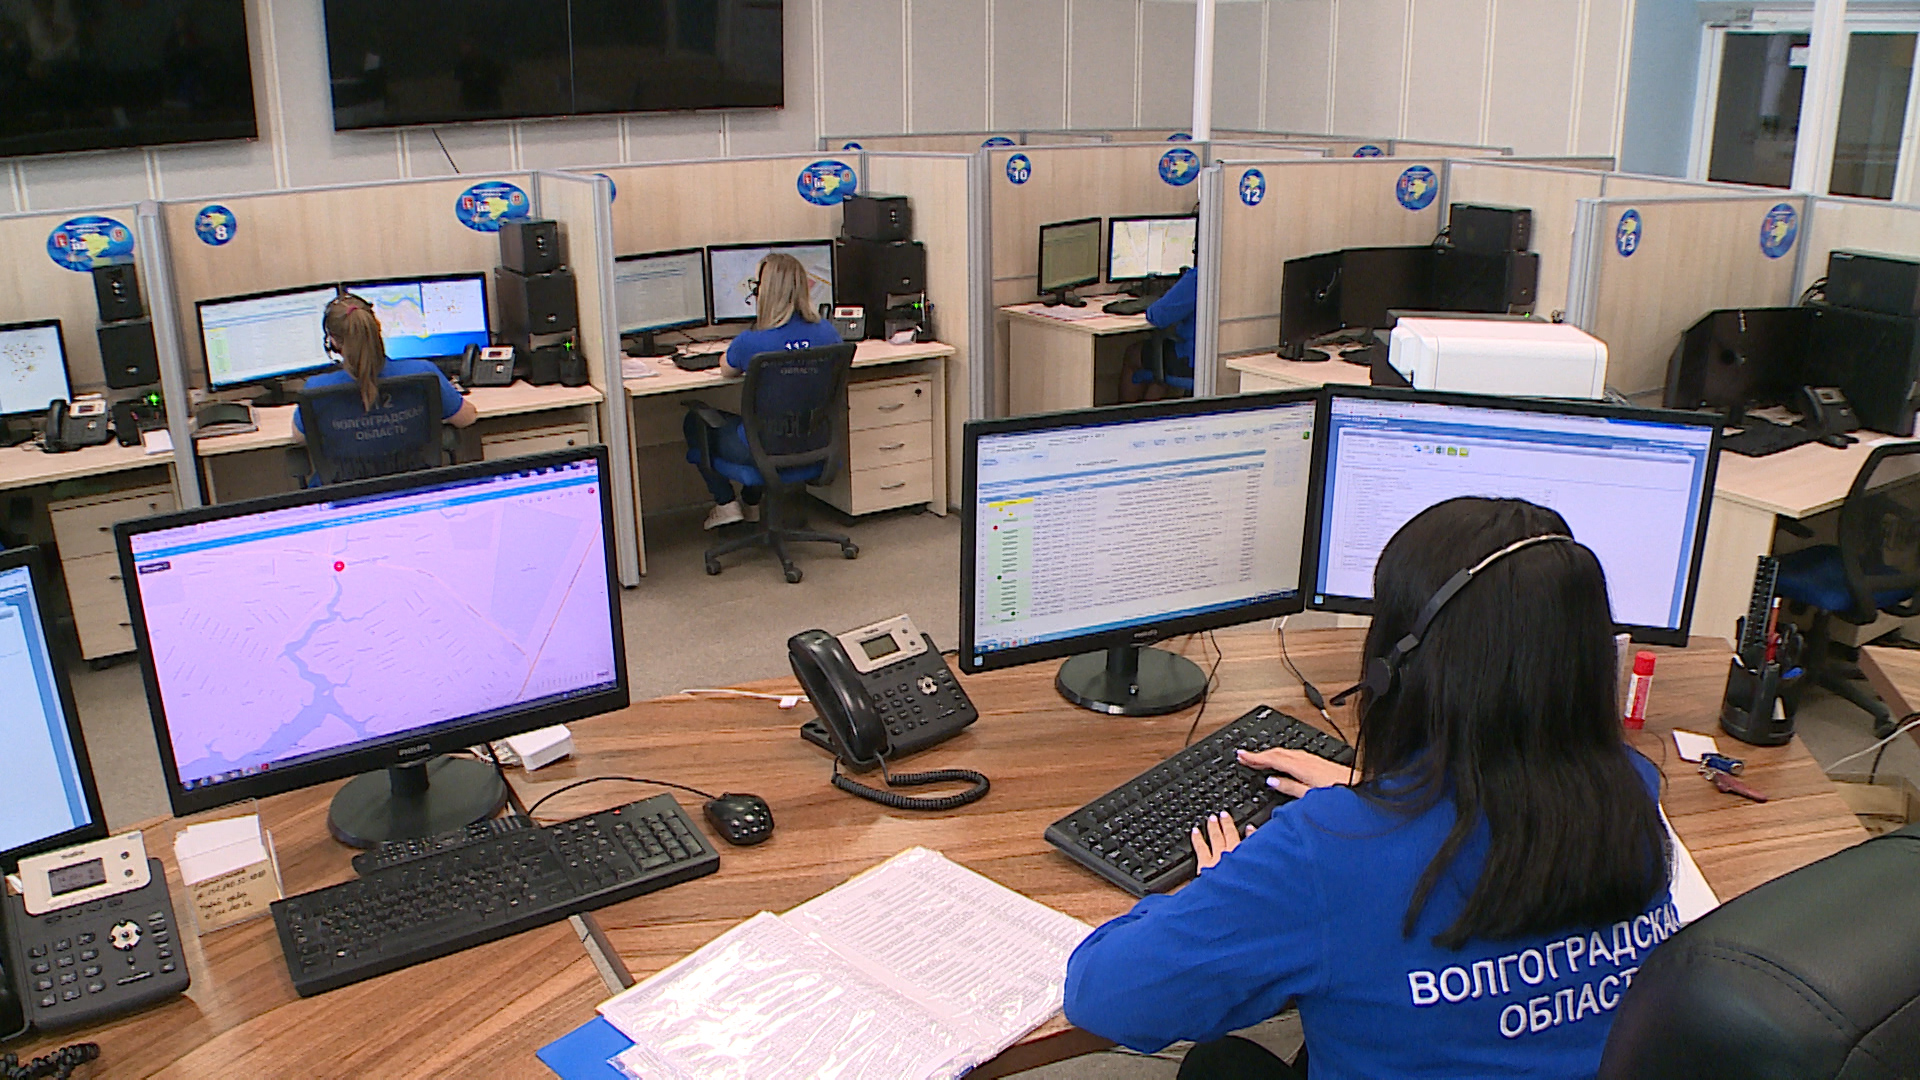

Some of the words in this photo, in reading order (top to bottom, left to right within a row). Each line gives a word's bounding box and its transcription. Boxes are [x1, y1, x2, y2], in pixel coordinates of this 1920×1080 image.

[1014, 170, 1028, 181] 10
[1244, 188, 1260, 203] 12
[215, 225, 228, 240] 8
[1621, 234, 1635, 251] 13
[1500, 967, 1639, 1038] ОБЛАСТ
